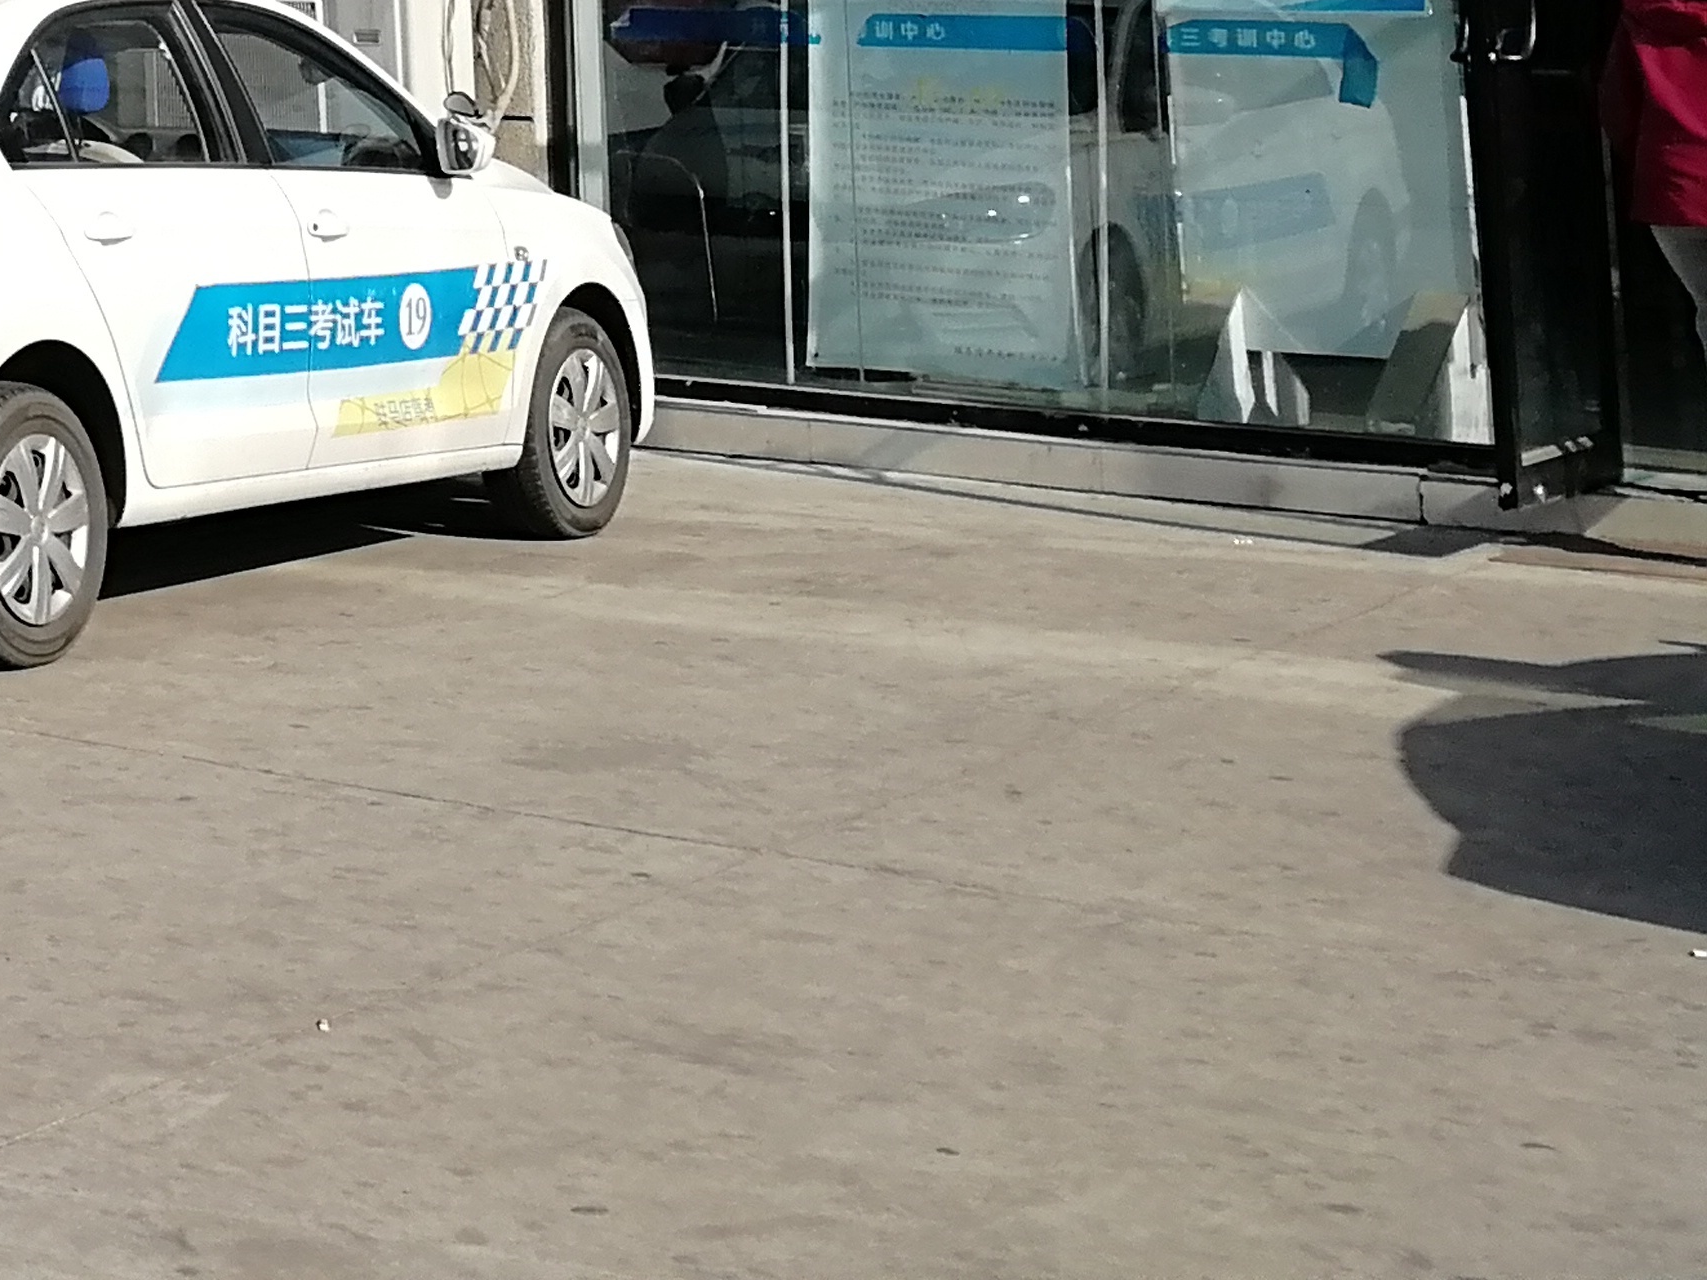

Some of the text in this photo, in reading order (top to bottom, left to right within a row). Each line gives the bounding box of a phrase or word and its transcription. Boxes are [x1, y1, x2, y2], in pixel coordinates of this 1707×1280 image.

[227, 296, 428, 357] 科目三考试车 19
